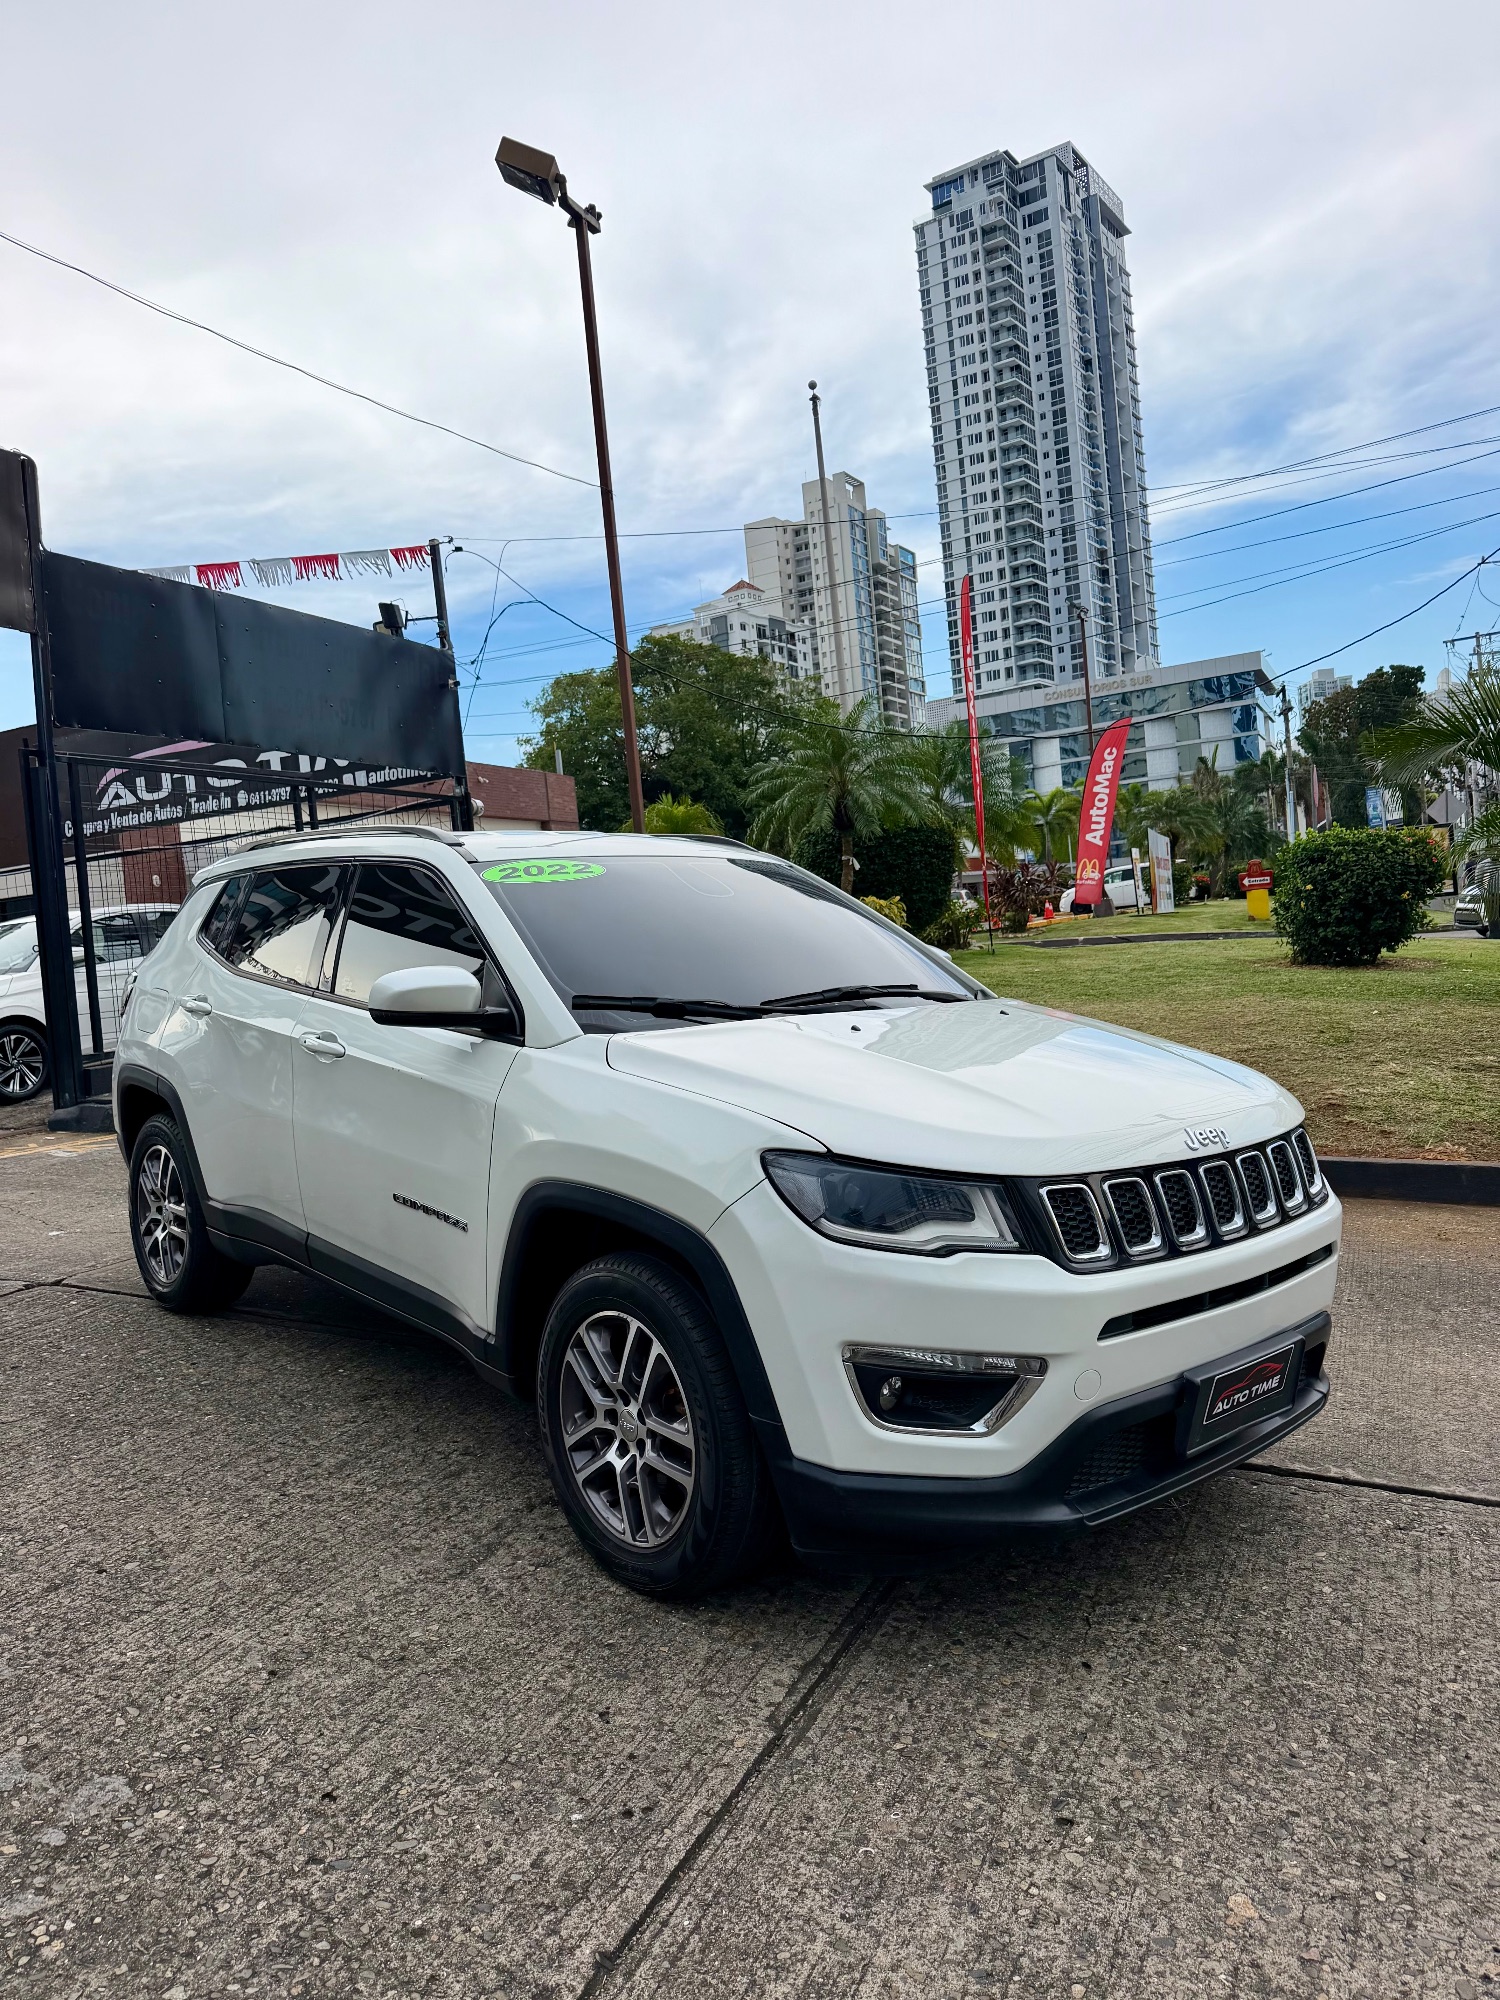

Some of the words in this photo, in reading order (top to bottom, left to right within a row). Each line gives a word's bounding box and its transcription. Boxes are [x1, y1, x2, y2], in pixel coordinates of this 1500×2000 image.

[1130, 675, 1153, 686] SUR
[1085, 747, 1117, 847] AutoMac
[110, 811, 139, 829] Venta
[139, 807, 152, 824] de
[154, 804, 183, 823] Autos
[189, 795, 219, 815] Trade
[499, 863, 594, 880] 2022
[1184, 1127, 1231, 1151] Jeep
[1212, 1389, 1250, 1415] AUTO
[1251, 1374, 1281, 1398] TIME
